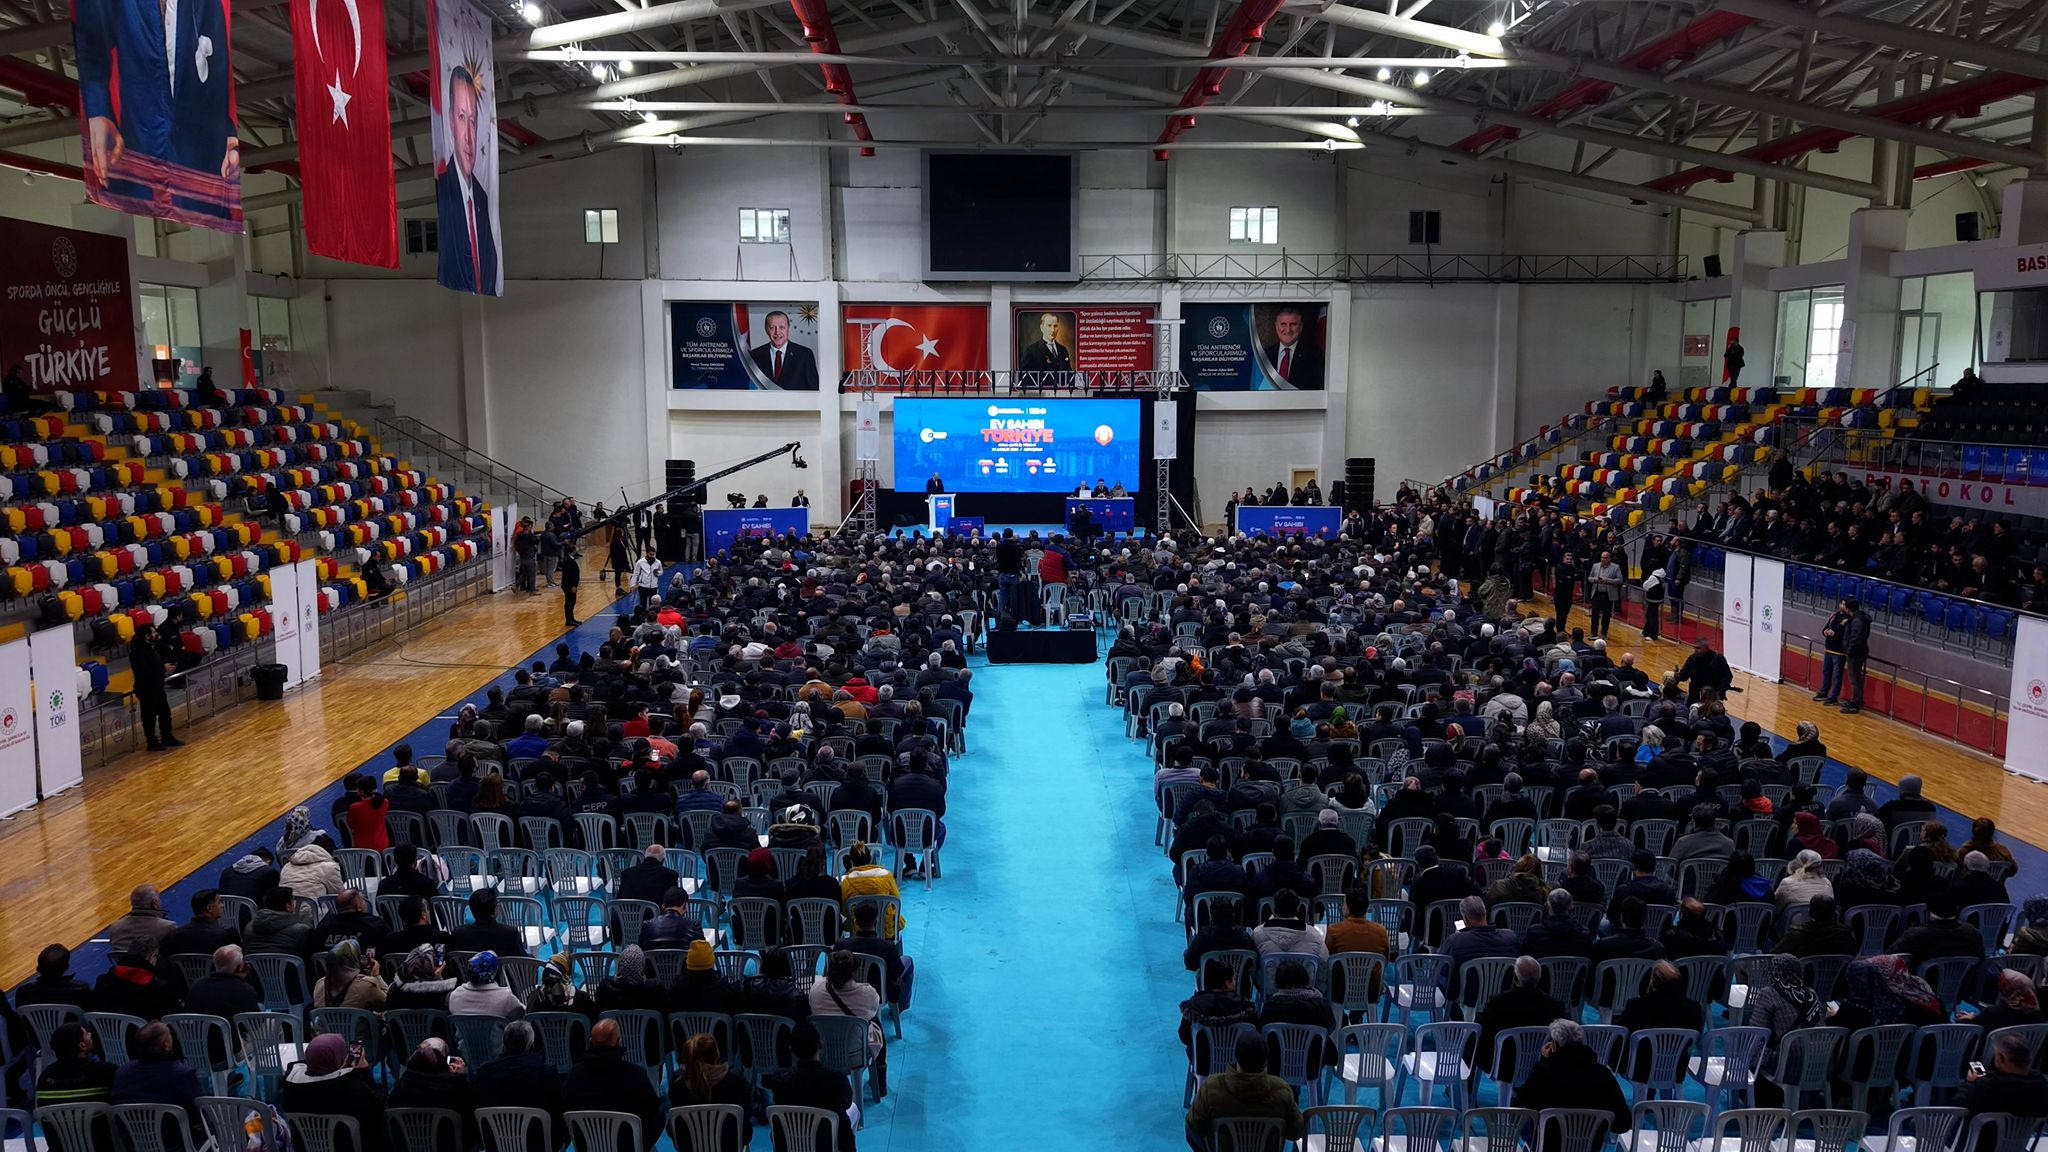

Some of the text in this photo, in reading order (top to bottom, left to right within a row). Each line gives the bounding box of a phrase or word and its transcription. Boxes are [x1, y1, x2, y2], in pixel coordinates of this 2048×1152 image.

[2017, 255, 2048, 272] BAS
[7, 284, 42, 299] SPORDA
[72, 279, 121, 298] GENÇLİĞİYLE
[38, 298, 101, 337] GÜÇLÜ
[24, 339, 111, 390] TÜRKİYE
[990, 419, 1006, 429] EV
